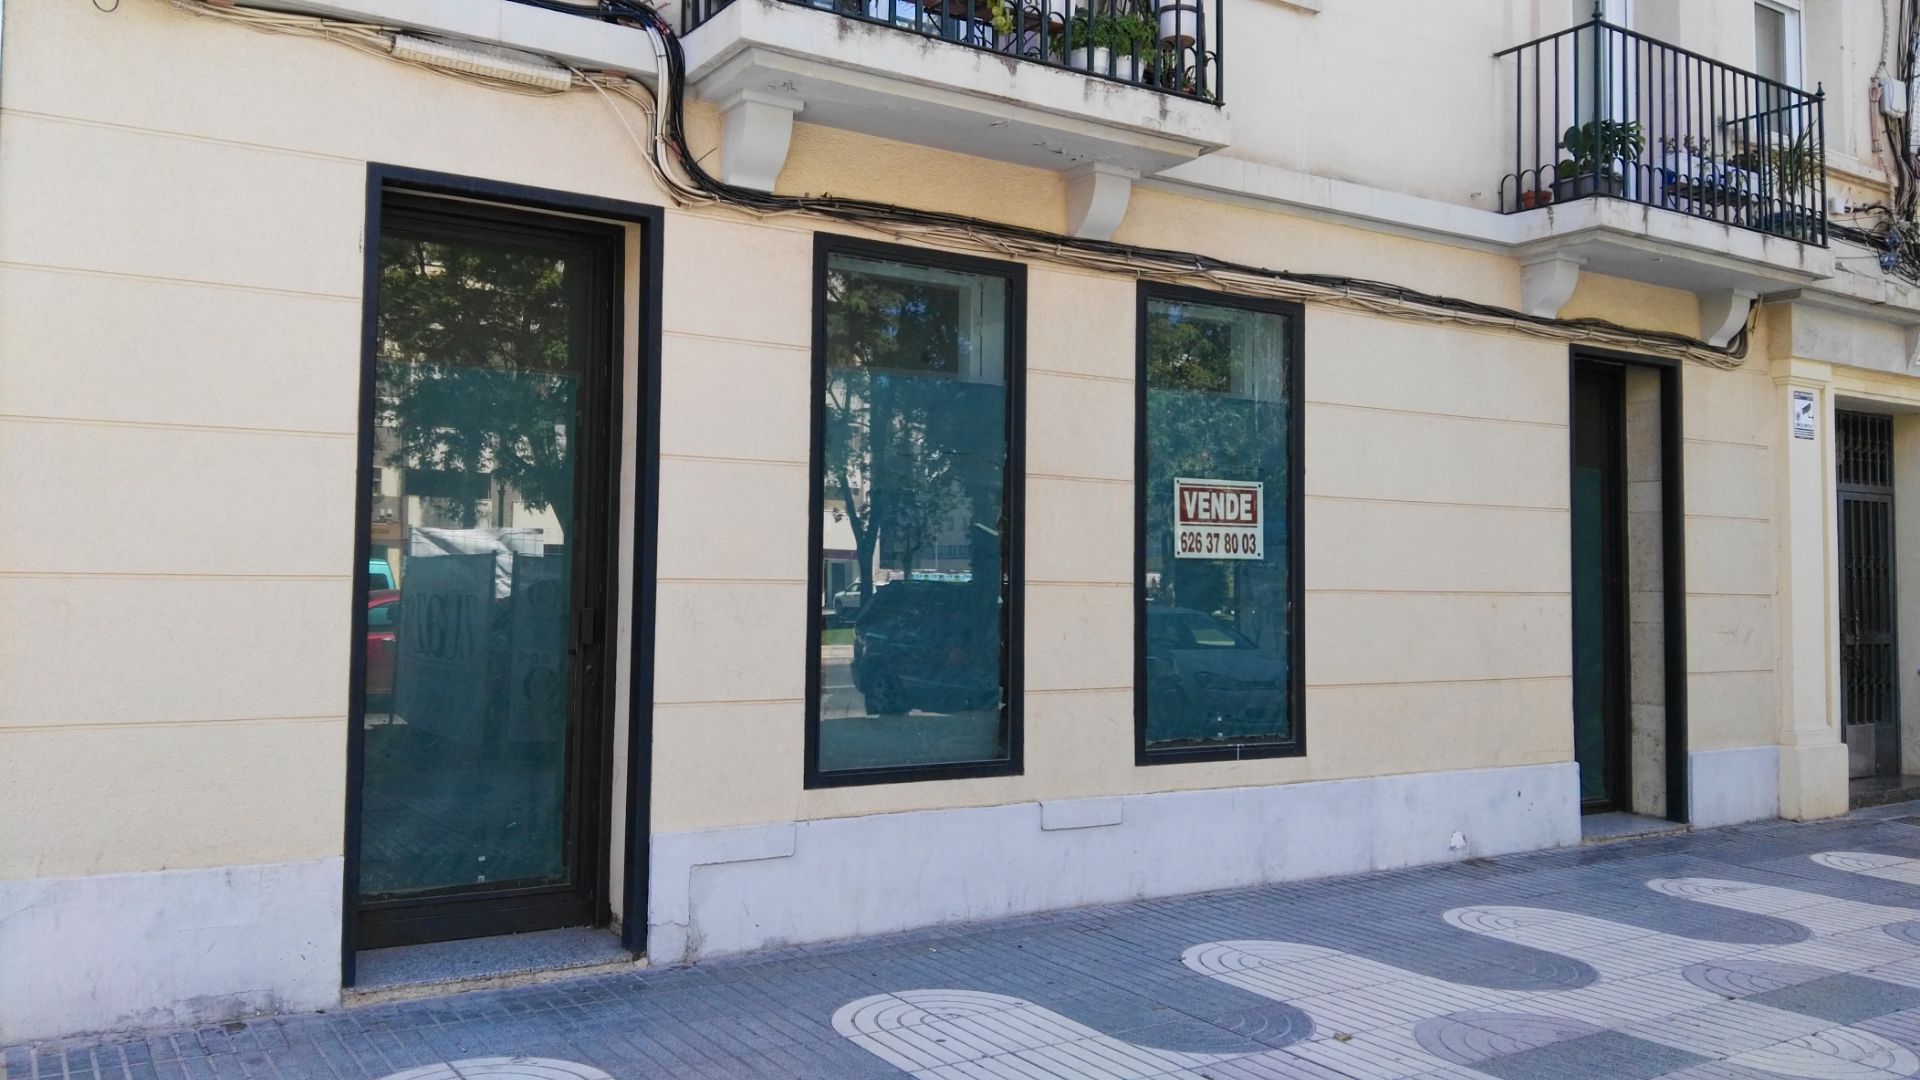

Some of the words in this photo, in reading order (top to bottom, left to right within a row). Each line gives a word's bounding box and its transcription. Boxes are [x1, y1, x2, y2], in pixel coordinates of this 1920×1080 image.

[1183, 491, 1253, 520] VENDE
[1180, 532, 1202, 553] 626
[1206, 532, 1220, 553] 37
[1224, 533, 1239, 554] 80
[1242, 533, 1257, 554] 03
